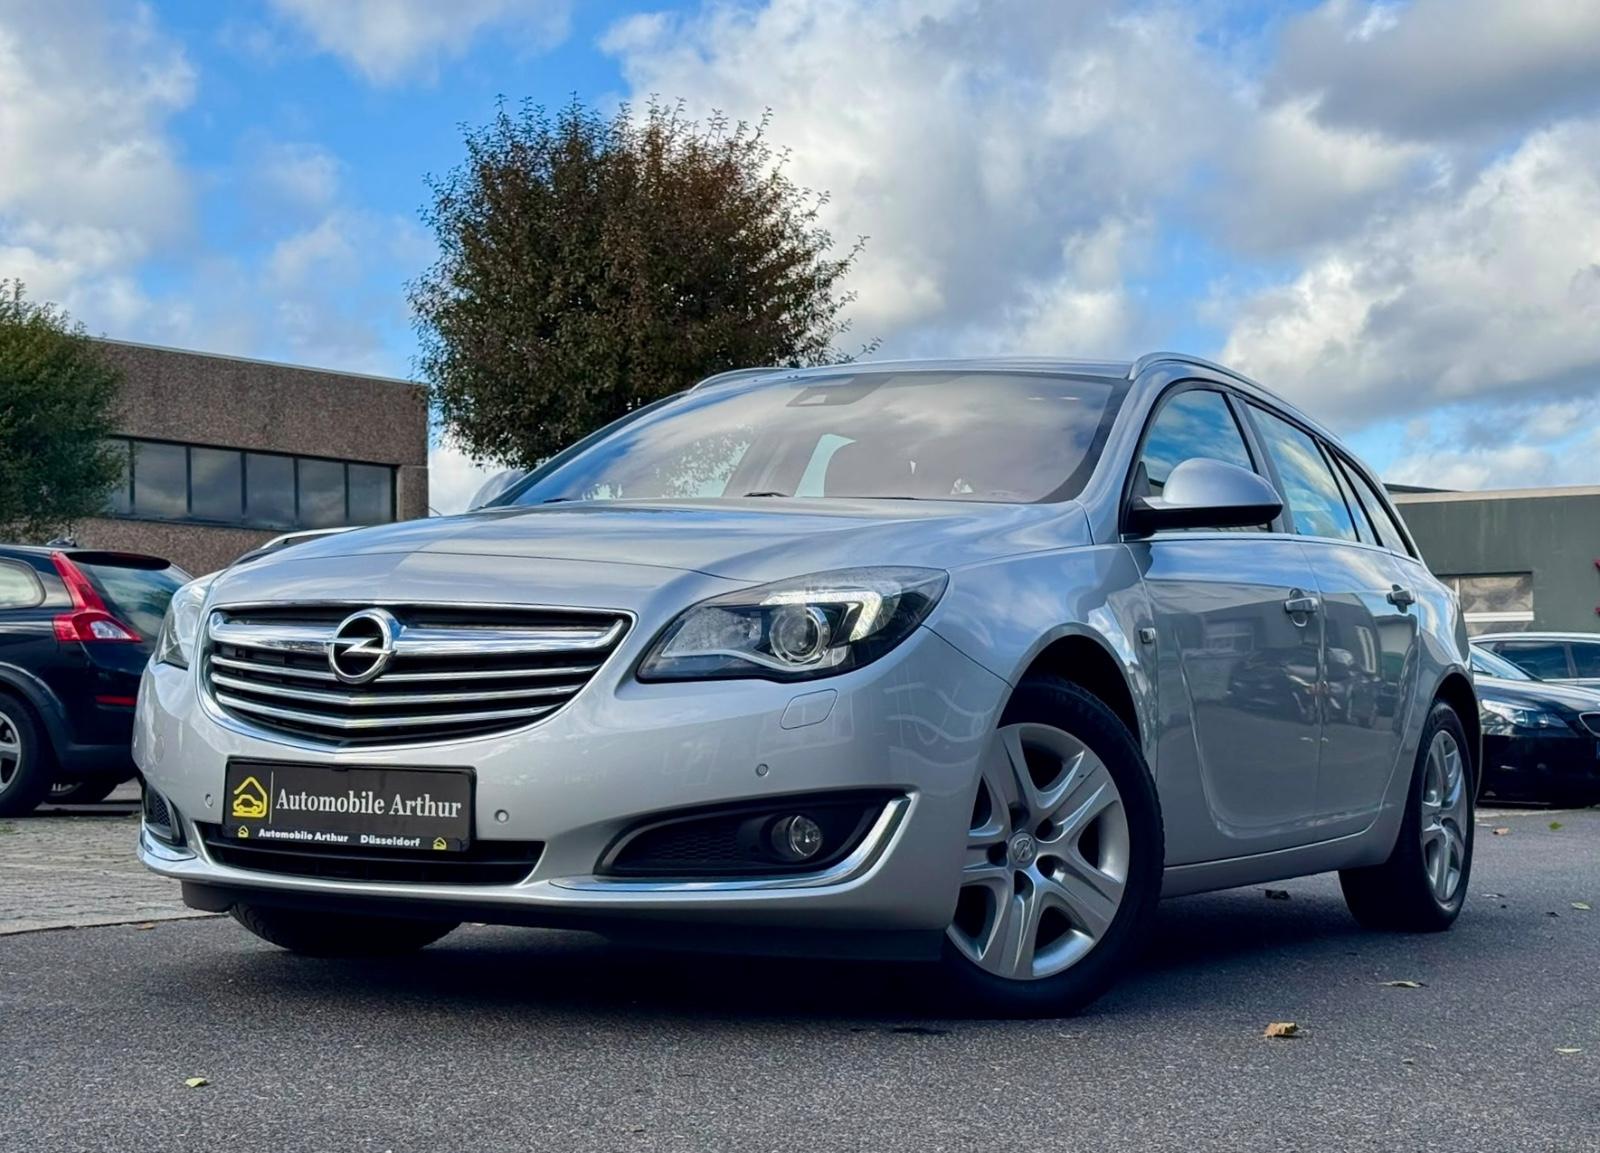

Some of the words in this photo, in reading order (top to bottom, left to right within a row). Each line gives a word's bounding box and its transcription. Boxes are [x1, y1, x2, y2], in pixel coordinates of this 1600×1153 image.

[275, 788, 385, 815] Automobile
[388, 793, 462, 818] Arthur
[258, 828, 313, 841] Automobile
[314, 831, 349, 843] Arthur
[360, 834, 421, 847] Düsseldorf
